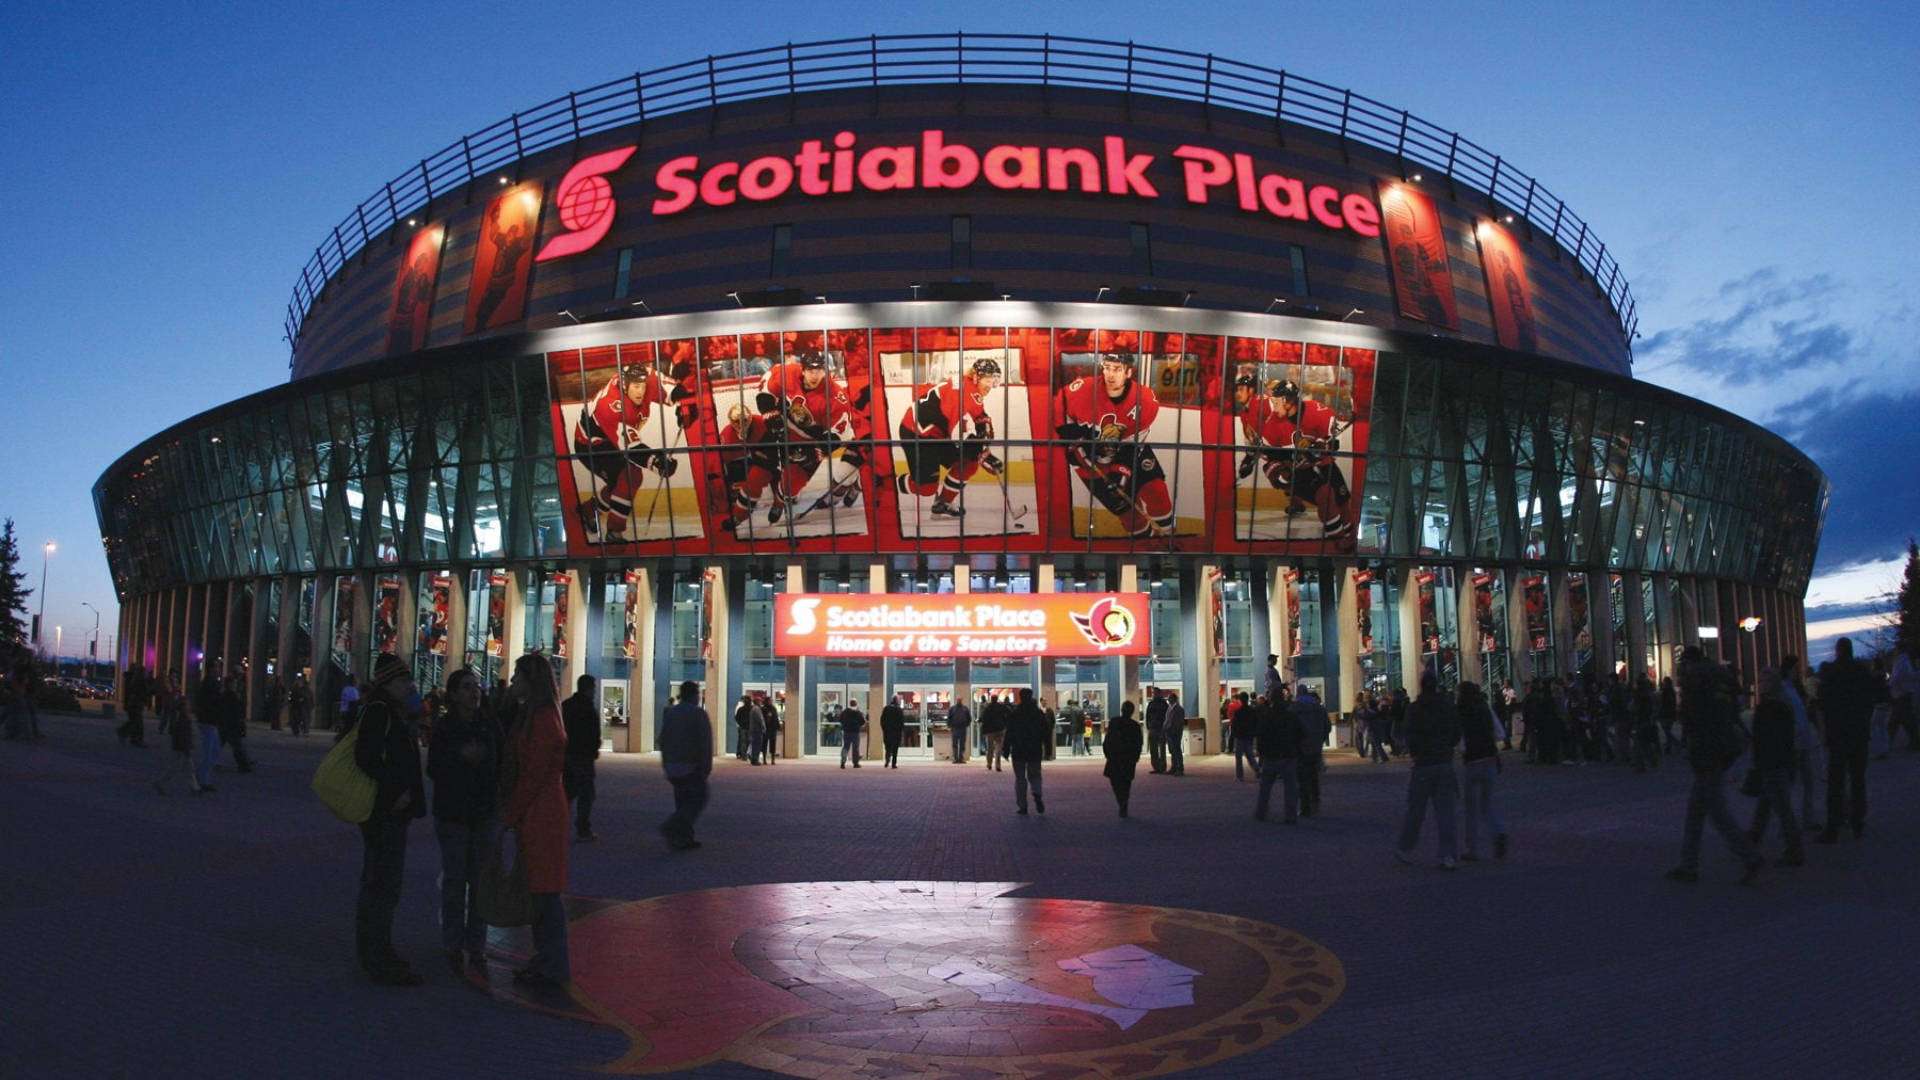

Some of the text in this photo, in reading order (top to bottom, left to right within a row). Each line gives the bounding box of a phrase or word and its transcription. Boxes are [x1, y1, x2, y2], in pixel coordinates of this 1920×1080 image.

[652, 130, 1380, 237] Scotiabank Place
[826, 604, 1046, 628] Scotiabank Place
[826, 634, 1047, 652] Home of the Senators
